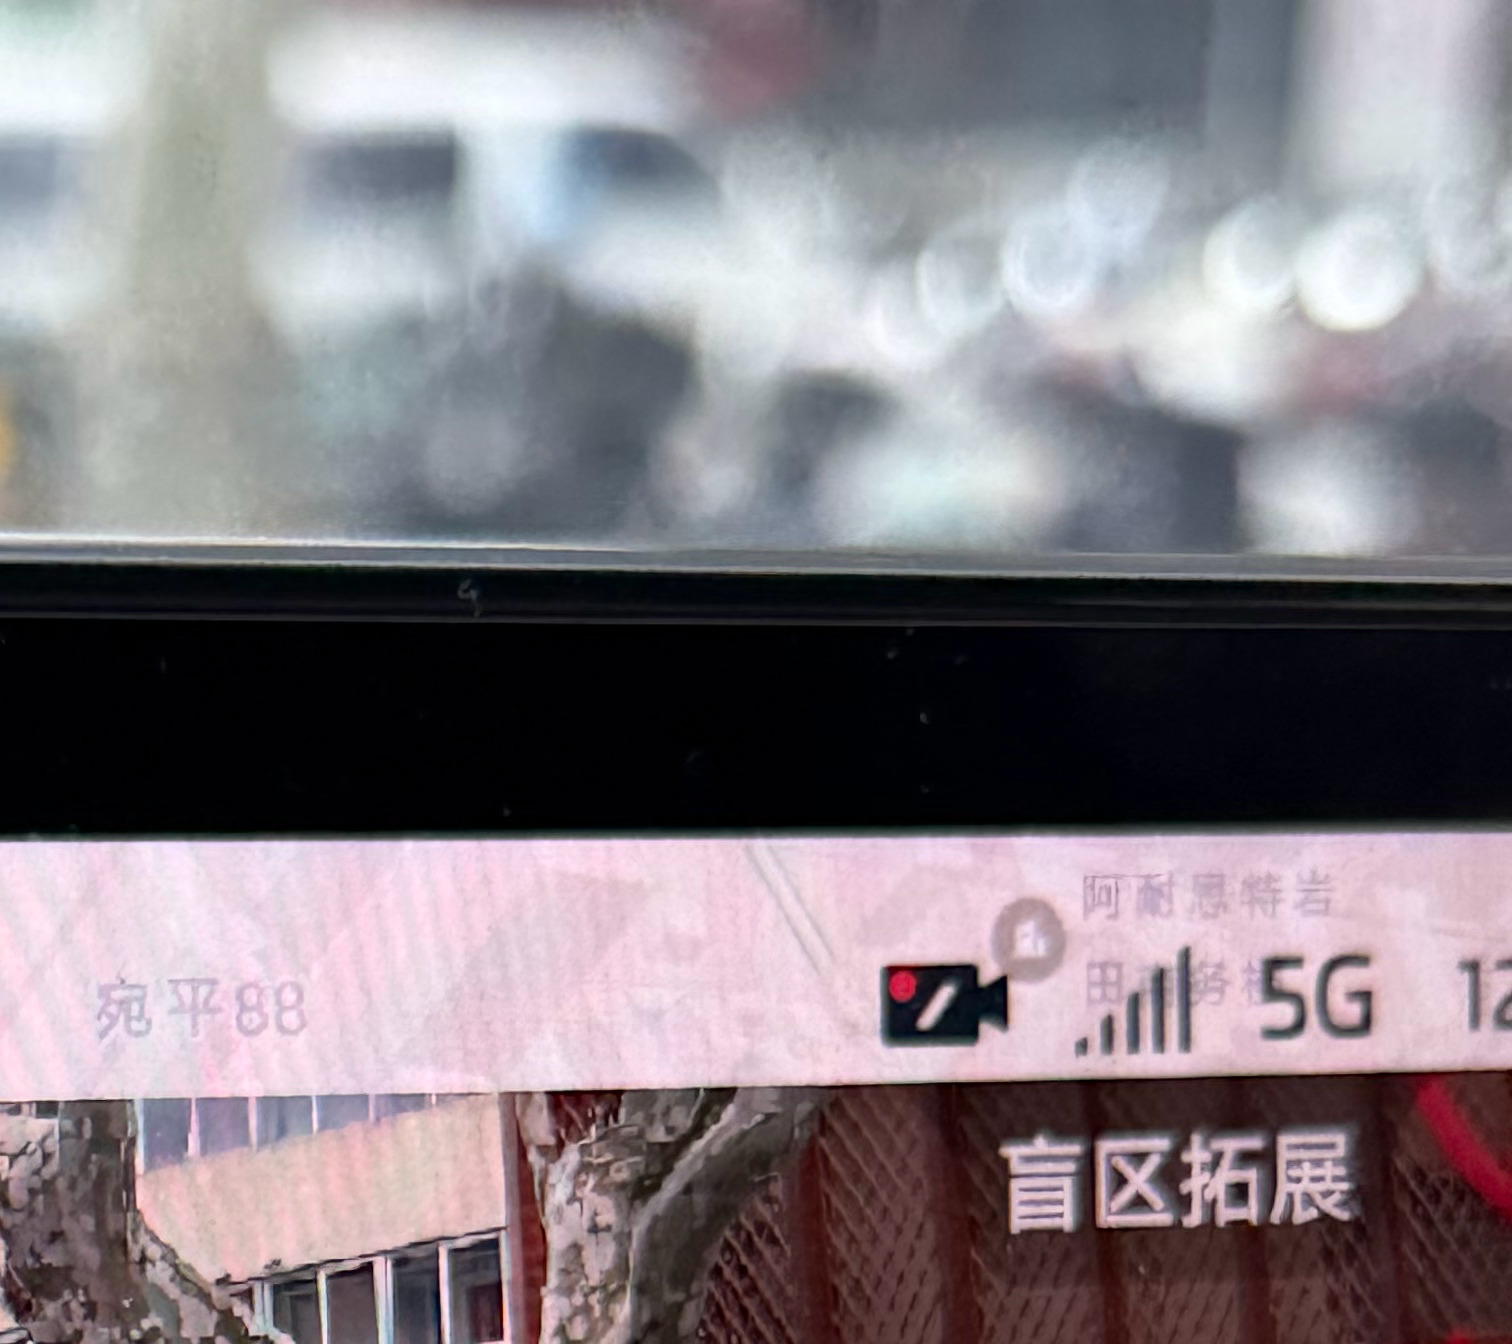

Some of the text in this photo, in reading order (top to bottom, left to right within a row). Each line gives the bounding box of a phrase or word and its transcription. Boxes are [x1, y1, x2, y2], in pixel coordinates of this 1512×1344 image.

[94, 973, 309, 1040] 宛平88
[1259, 953, 1374, 1040] 5G
[999, 1127, 1359, 1235] 盲区拓展
